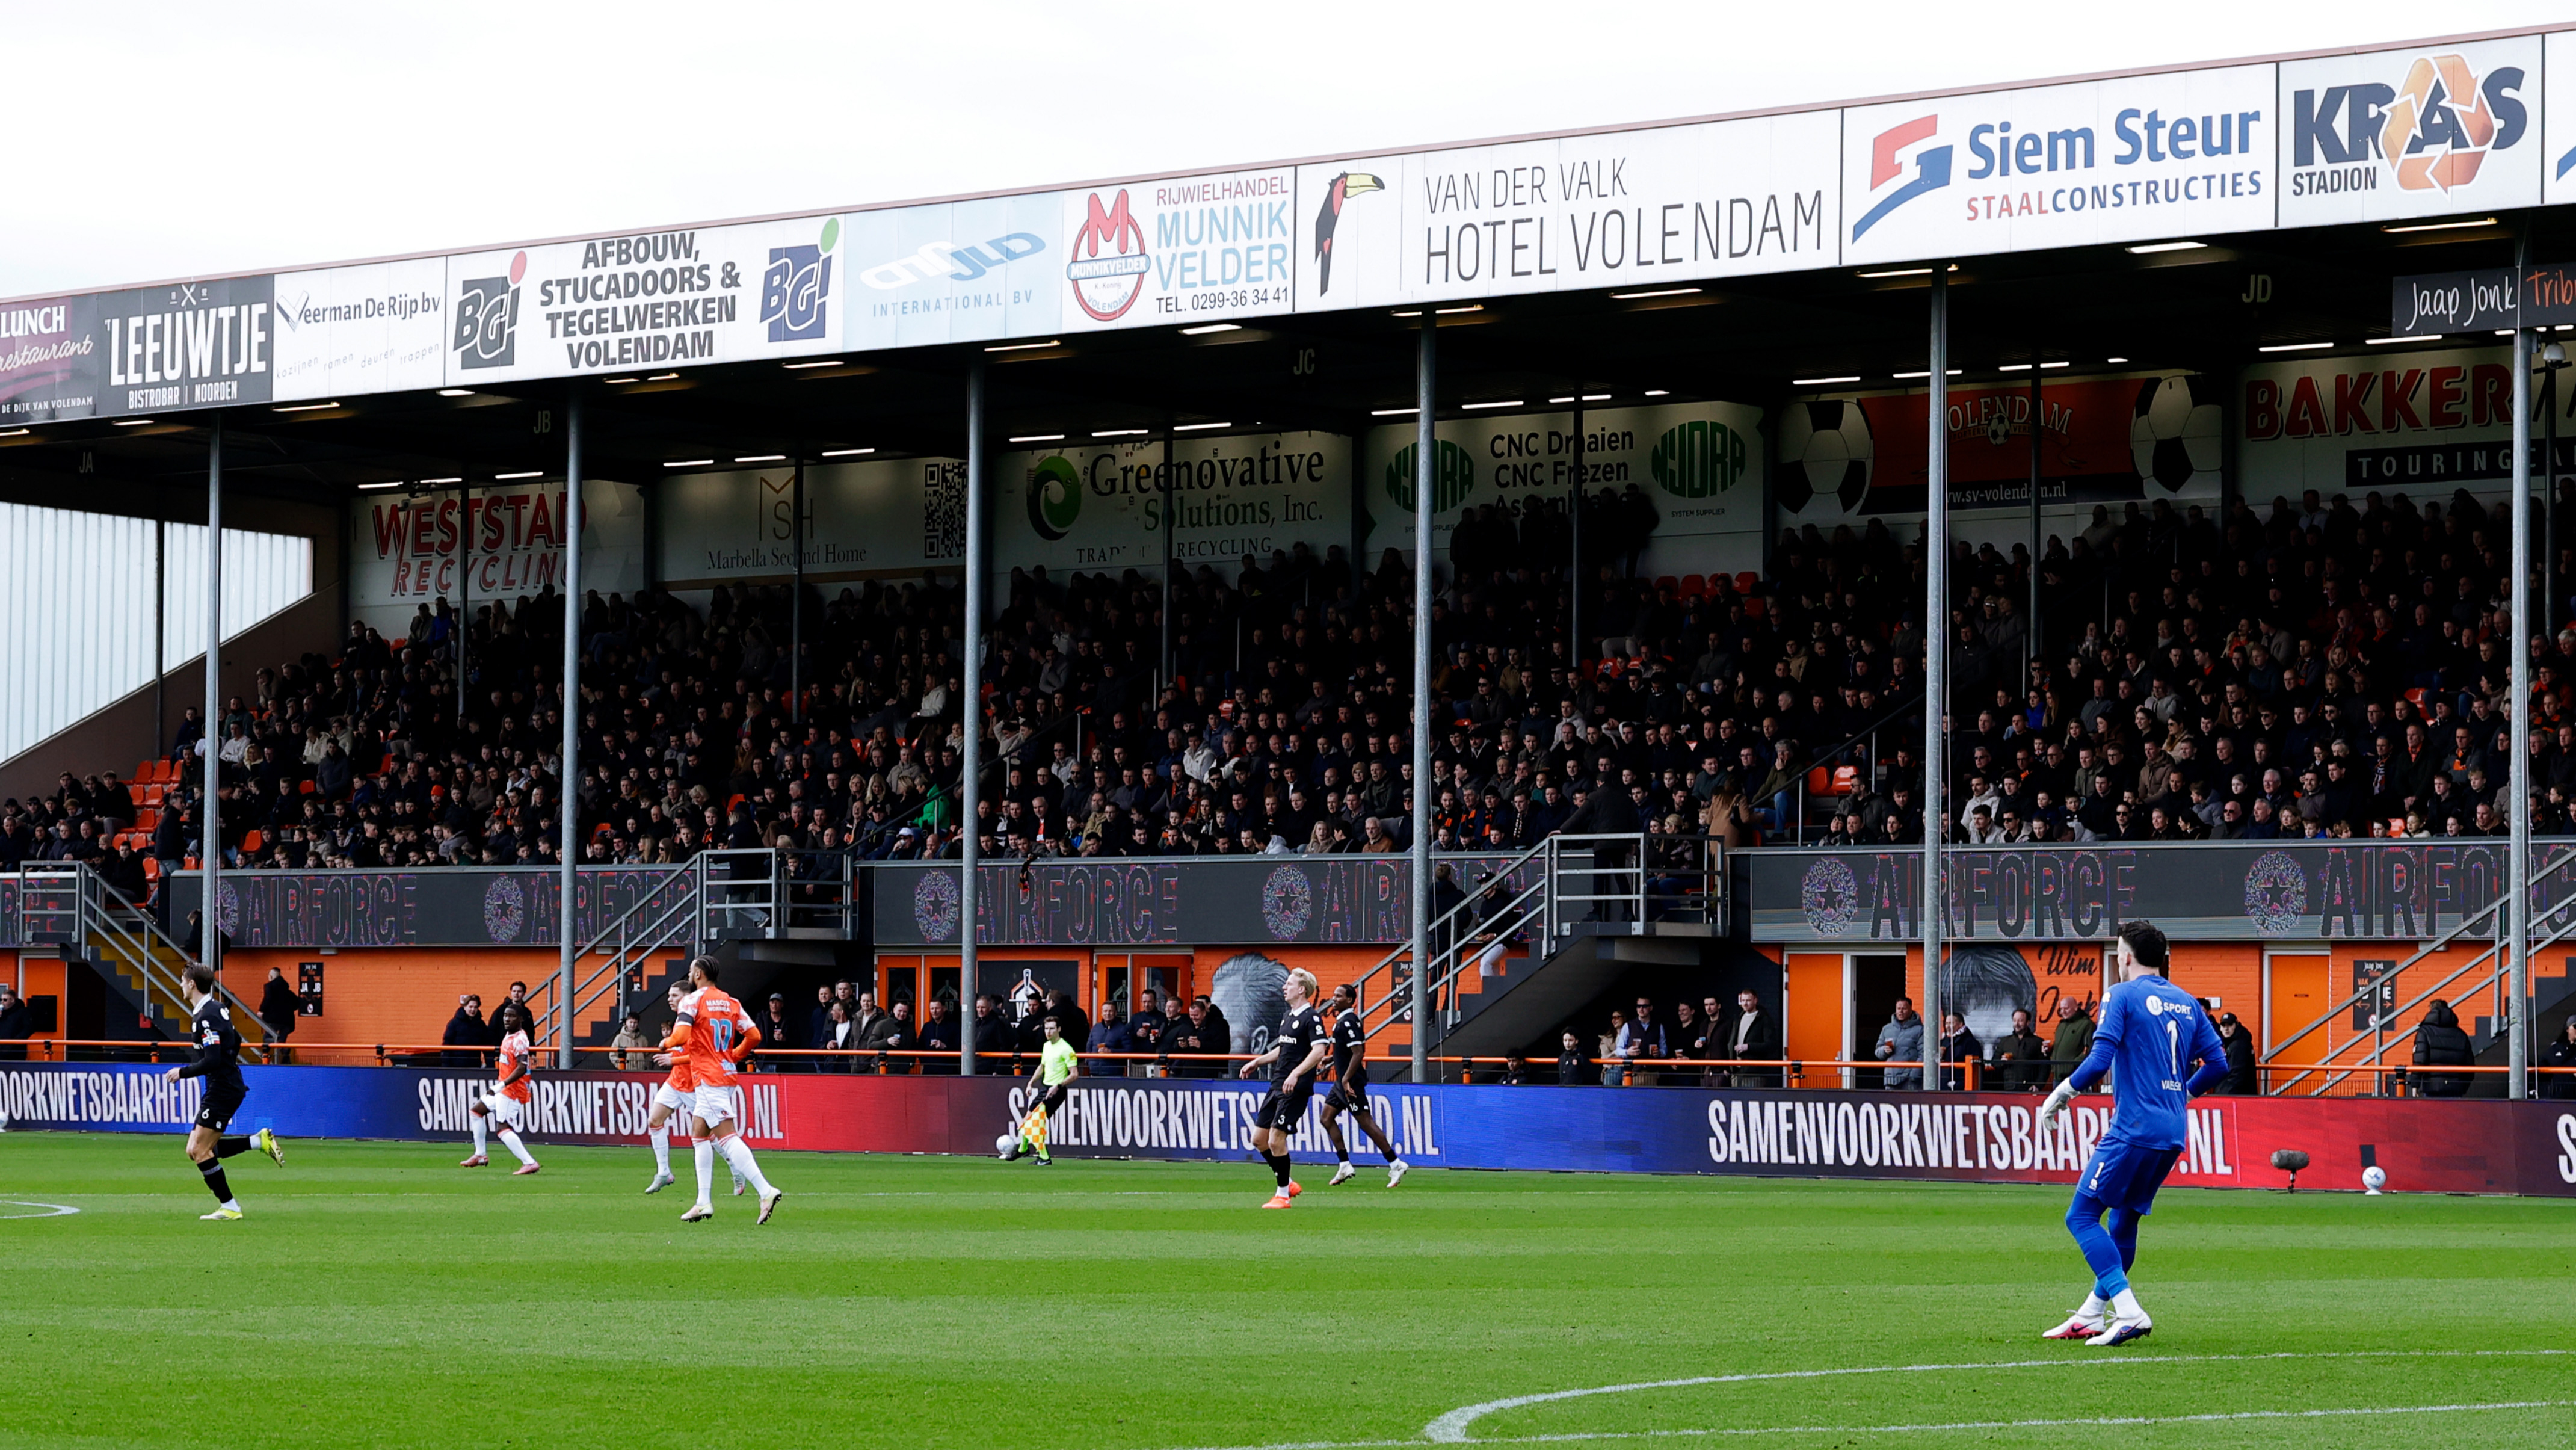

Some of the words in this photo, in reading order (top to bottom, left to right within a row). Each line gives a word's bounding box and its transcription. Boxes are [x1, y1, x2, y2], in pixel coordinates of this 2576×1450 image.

[2294, 66, 2527, 167] KRAS
[1968, 121, 2095, 180] Siem
[2113, 108, 2261, 165] Steur
[1157, 176, 1289, 206] RIJWIELHANDEL
[1425, 171, 1480, 214] VAN
[1493, 165, 1547, 208] DER
[1559, 157, 1628, 201] VALK
[1967, 170, 2262, 221] STAALCONSTRUCTIES
[2293, 166, 2377, 197] STADION
[1157, 200, 1288, 249] MUNNIK
[1426, 217, 1556, 285] HOTEL
[1570, 189, 1822, 271] VOLENDAM
[582, 232, 701, 269] AFBOUW,
[1070, 256, 1147, 279] MUNNIKVELDER
[1156, 242, 1289, 291] VELDER
[540, 264, 711, 307] STUCADOORS
[721, 261, 742, 289] &
[2242, 274, 2272, 303] JD
[365, 297, 385, 318] De
[388, 293, 419, 320] Rijp
[421, 291, 440, 313] bv
[873, 291, 1003, 318] INTERNATIONAL
[1014, 289, 1032, 305] BV
[1087, 291, 1130, 311] VOLENDAM
[1156, 296, 1187, 313] TEL.
[1191, 290, 1248, 311] 0299-36
[1252, 289, 1268, 305] 34
[1272, 287, 1289, 304] 41
[2405, 282, 2459, 331] Jaap
[2464, 276, 2516, 326] Jonk
[2525, 269, 2576, 308] Trib
[0, 306, 66, 338] LUNCH
[546, 295, 736, 339] TEGELWERKEN
[110, 303, 267, 386] LEEUWTJE
[567, 330, 713, 369] VOLENDAM
[276, 356, 319, 380] kozijnen
[323, 353, 354, 371] ramen
[361, 348, 395, 368] deuren
[400, 343, 440, 365] trappen
[1293, 348, 1316, 375] JC
[2, 404, 11, 413] DE
[14, 402, 30, 413] DIJK
[33, 400, 49, 410] VAN
[52, 396, 93, 409] VOLENDAM
[128, 386, 180, 409] BISTROBAR
[194, 381, 238, 403] NOORDEN
[534, 410, 551, 434] JB
[1490, 432, 1539, 459] CNC
[79, 452, 93, 474] JA
[1089, 440, 1324, 496] Greenovative
[1495, 462, 1544, 489] CNC
[2358, 446, 2576, 479] TOURING
[1283, 494, 1323, 522] Inc.
[707, 548, 767, 570] Marbella
[771, 544, 821, 566] Secnd
[824, 543, 867, 564] Home
[1176, 537, 1272, 558] RECYCLING
[244, 874, 418, 945] AIRFORCE
[2038, 943, 2098, 976] Wim
[2163, 1002, 2192, 1015] SPORT
[2167, 1020, 2178, 1075] 1
[201, 1108, 210, 1120] 6
[1277, 1114, 1286, 1125] 3
[1349, 1103, 1359, 1112] 16
[2095, 1162, 2105, 1179] 1
